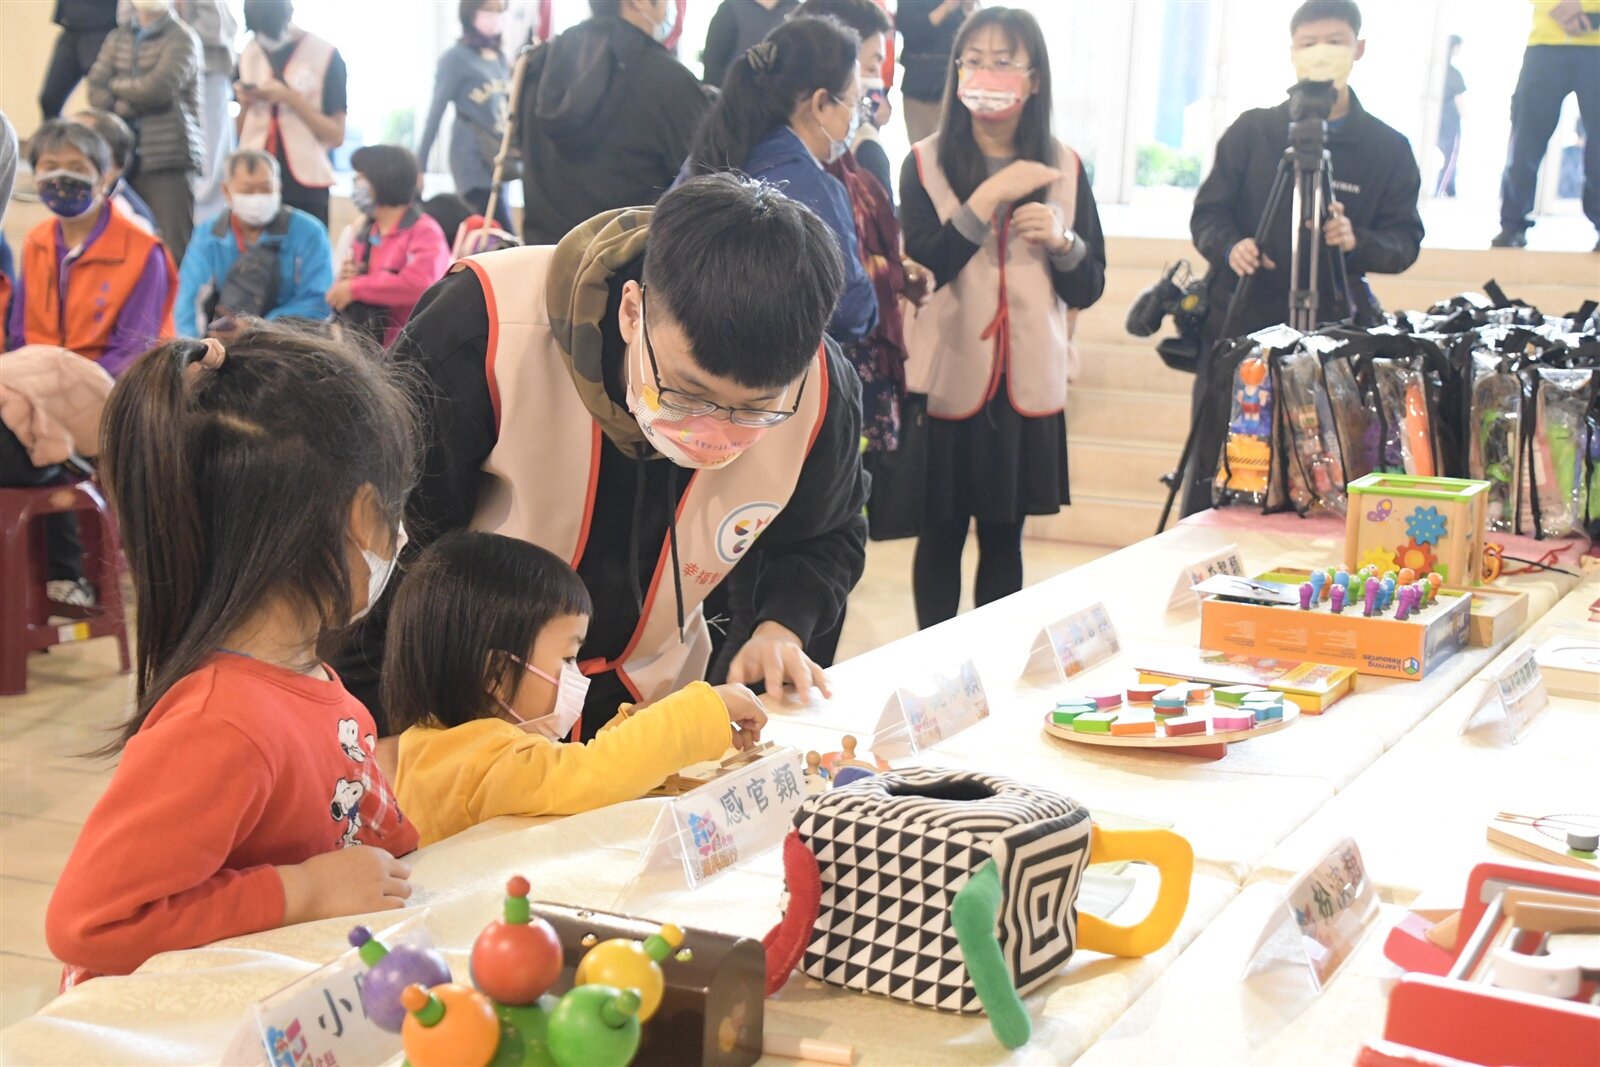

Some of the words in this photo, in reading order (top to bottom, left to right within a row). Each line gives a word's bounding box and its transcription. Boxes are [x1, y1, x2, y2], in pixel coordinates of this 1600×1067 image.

[1363, 654, 1401, 665] Resources
[1368, 661, 1401, 672] Learning
[719, 763, 800, 828] 感官類
[318, 972, 368, 1038] 小
